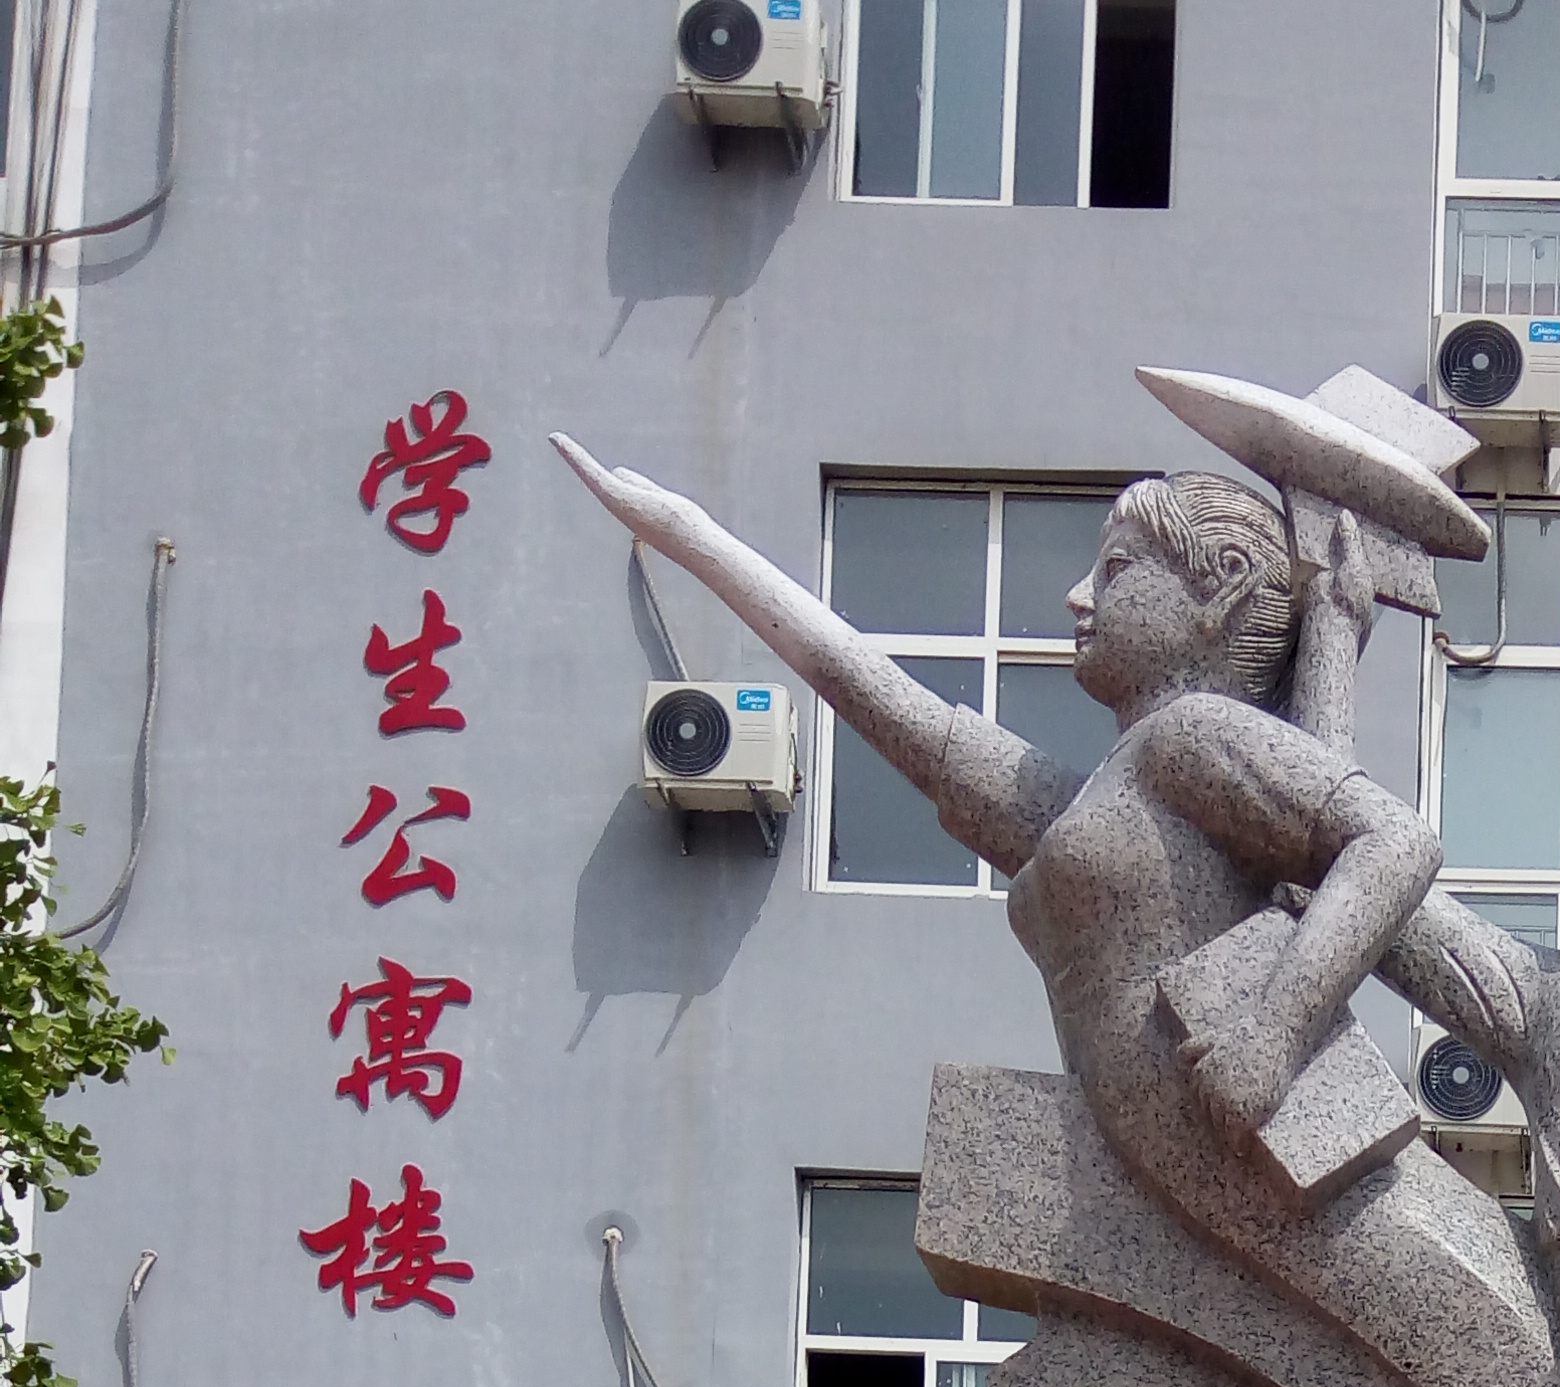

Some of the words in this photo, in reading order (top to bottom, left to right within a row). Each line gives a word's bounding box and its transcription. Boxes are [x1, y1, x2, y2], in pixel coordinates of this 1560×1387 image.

[300, 391, 491, 1314] 学生公寓楼
